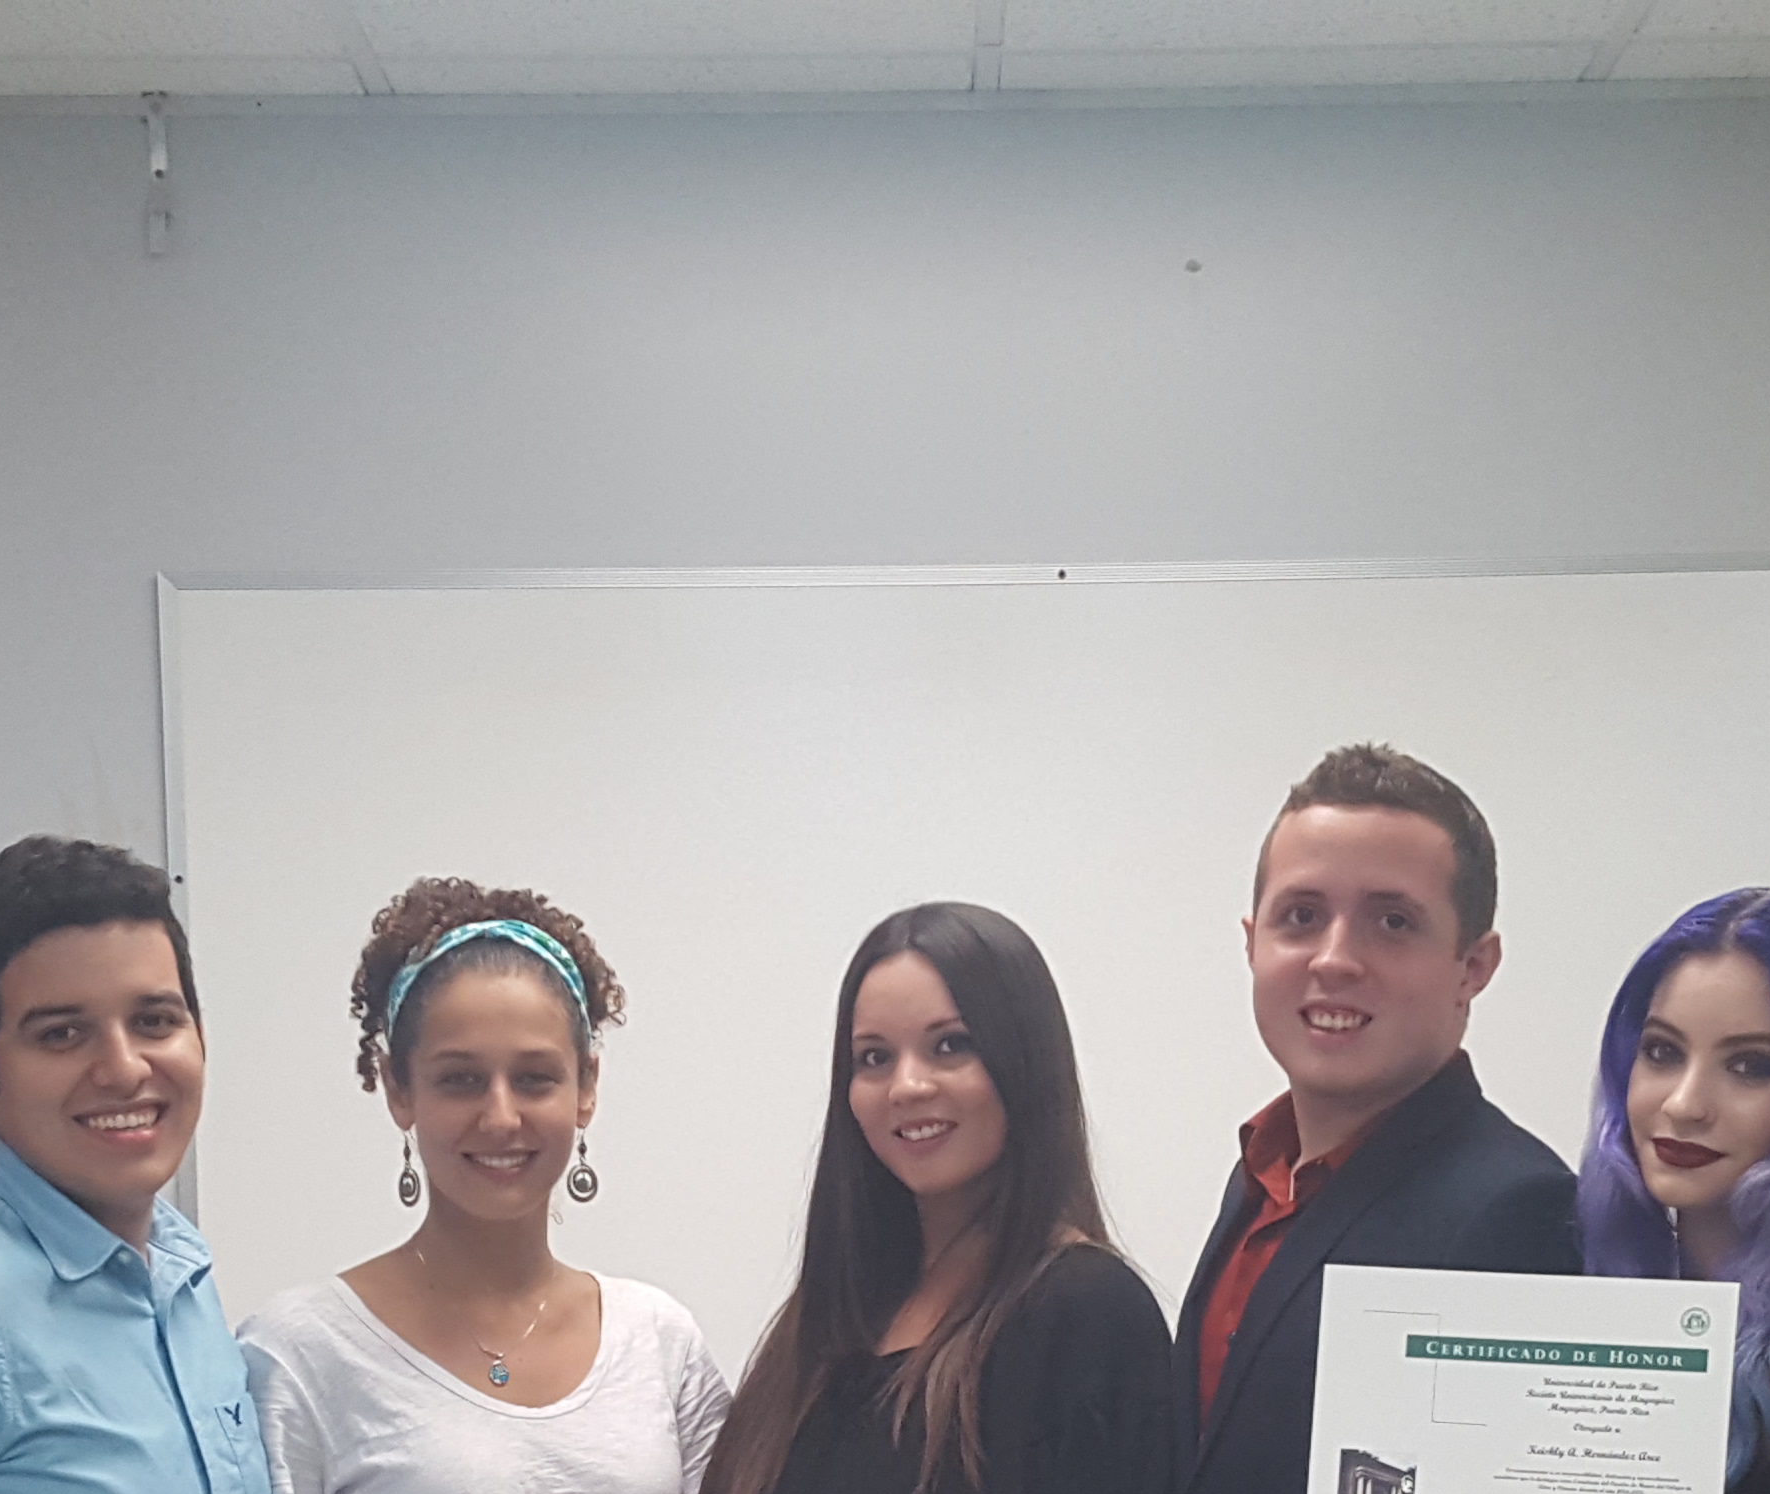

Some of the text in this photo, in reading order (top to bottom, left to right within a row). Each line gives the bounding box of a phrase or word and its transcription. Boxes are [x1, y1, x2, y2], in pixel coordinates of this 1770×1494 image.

[1425, 1340, 1682, 1367] CERTIFICADO DE HONOR
